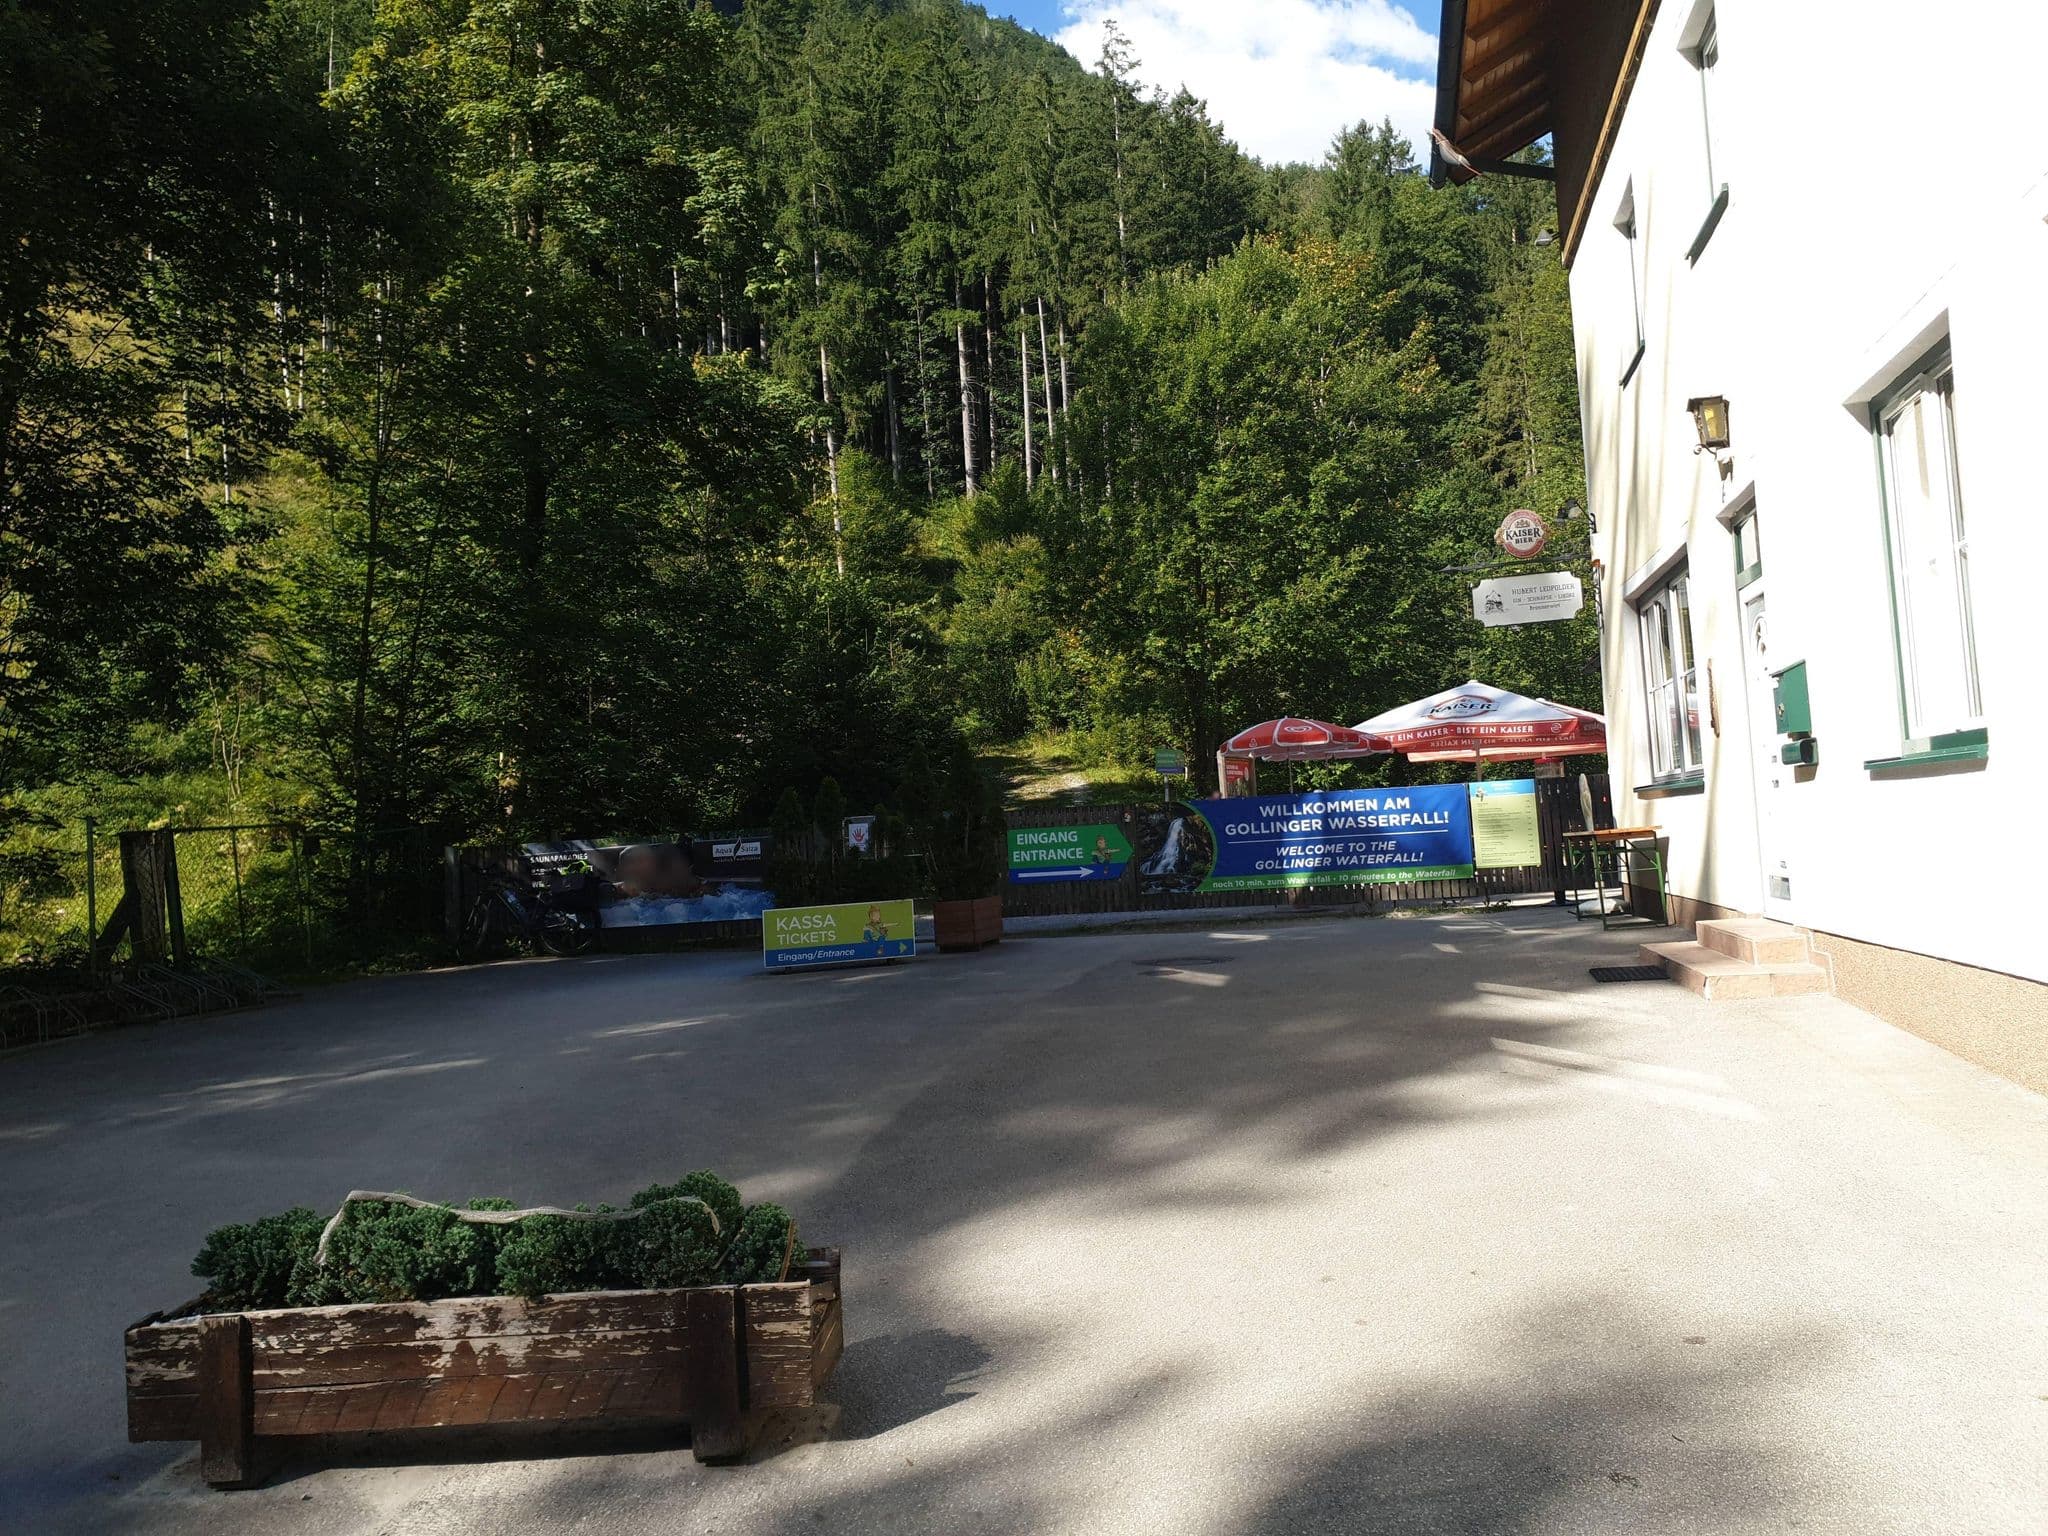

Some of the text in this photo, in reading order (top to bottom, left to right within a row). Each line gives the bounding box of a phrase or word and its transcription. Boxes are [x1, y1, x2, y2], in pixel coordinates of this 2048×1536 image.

[1506, 528, 1541, 540] KAISER
[1512, 587, 1537, 595] HUBERT
[1430, 703, 1492, 714] KAISER
[1398, 733, 1414, 741] EIN
[1417, 728, 1449, 739] KAISER
[1260, 797, 1410, 817] WILLKOMMEN AM
[1225, 811, 1449, 835] GOLLINGER WASSERFALL!
[1017, 831, 1078, 845] EINGANG
[1013, 848, 1084, 862] ENTRANCE
[1276, 841, 1397, 856] WELCOME TO THE
[530, 853, 588, 863] SAUNAPARADIES
[1255, 852, 1423, 870] GOLLINGER WATERFALL!
[1287, 876, 1330, 884] Wasserfall
[1351, 872, 1384, 880] minutes
[1415, 869, 1455, 877] Waterfall
[776, 914, 836, 931] KASSA
[777, 930, 836, 945] TICKETS
[778, 949, 855, 961] Eingang/Entrance
